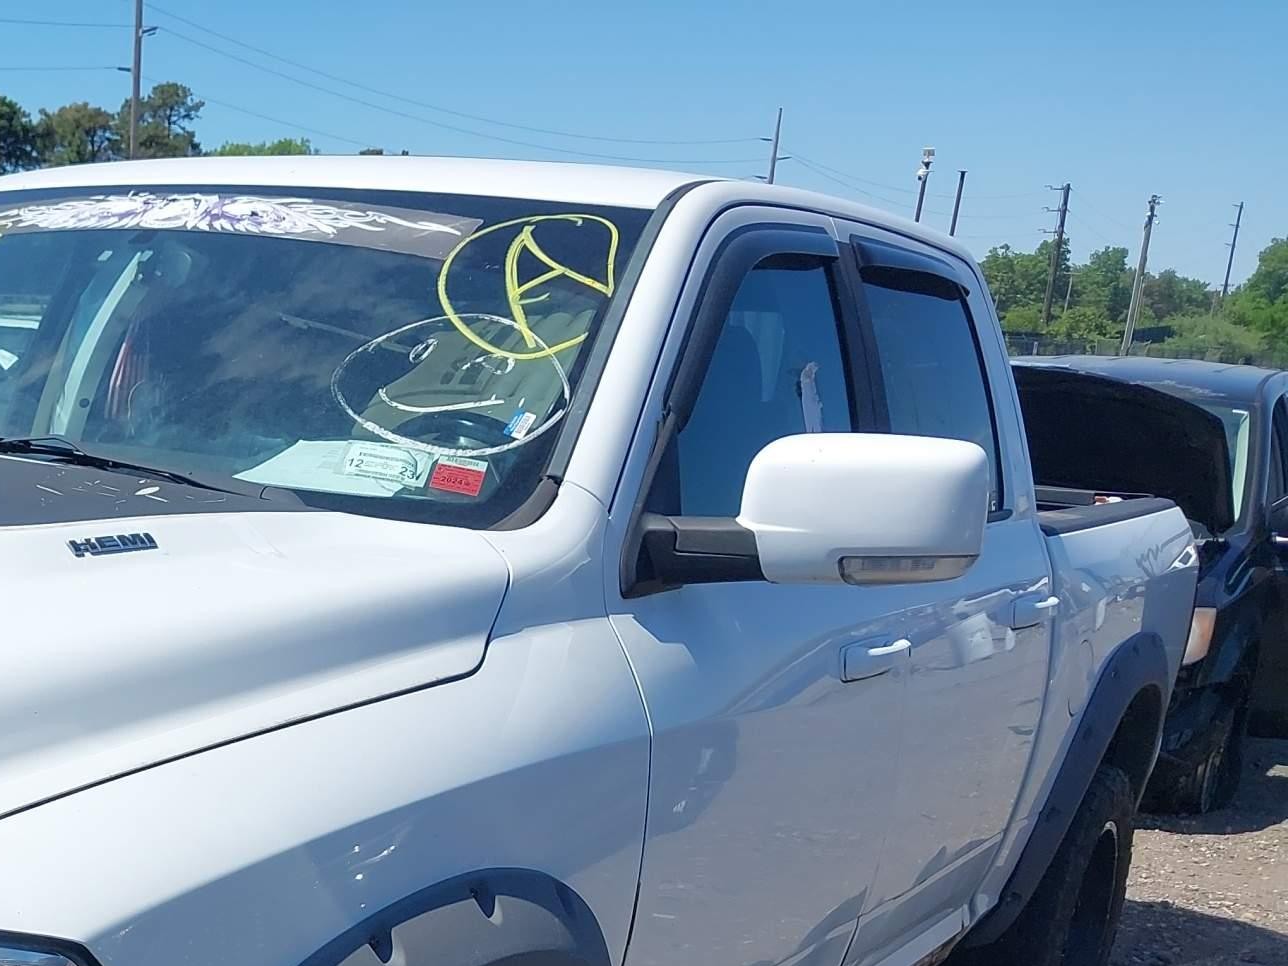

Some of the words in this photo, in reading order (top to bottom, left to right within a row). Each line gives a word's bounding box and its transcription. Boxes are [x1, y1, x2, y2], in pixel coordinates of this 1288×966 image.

[347, 458, 364, 468] 12
[399, 466, 416, 480] 23
[67, 532, 159, 558] HEMI
